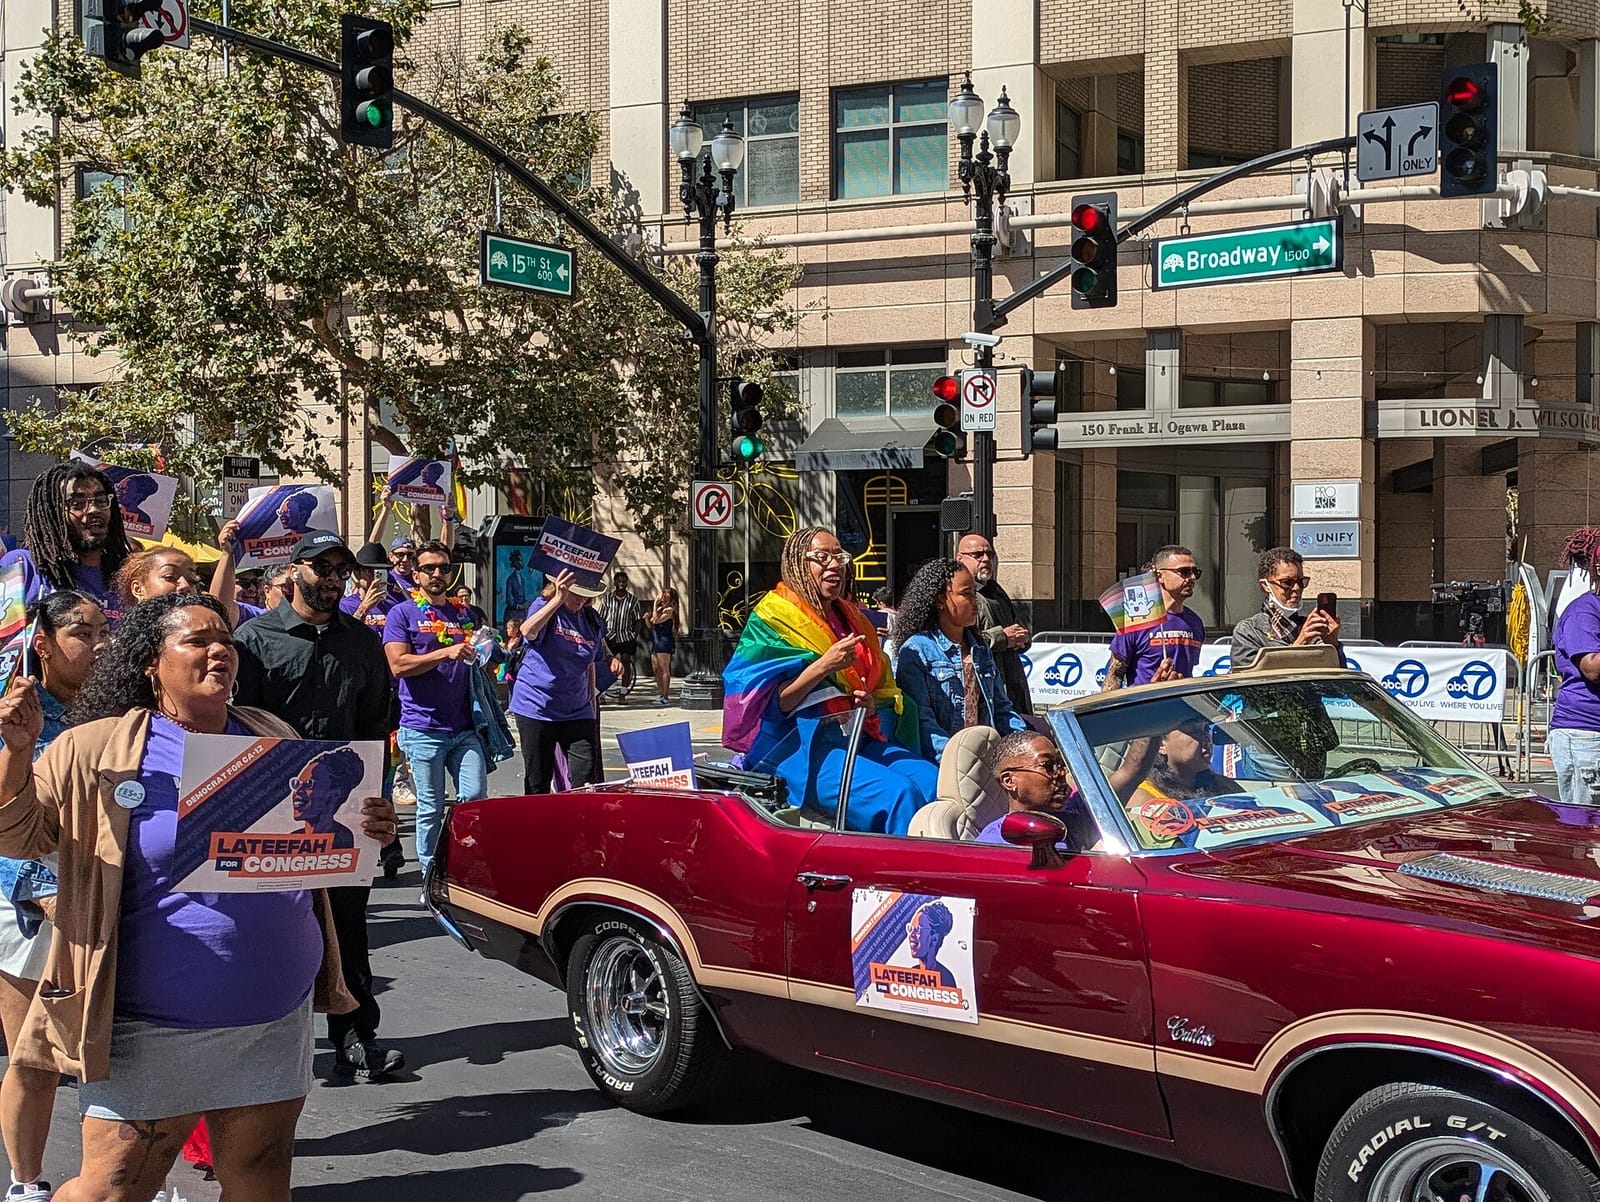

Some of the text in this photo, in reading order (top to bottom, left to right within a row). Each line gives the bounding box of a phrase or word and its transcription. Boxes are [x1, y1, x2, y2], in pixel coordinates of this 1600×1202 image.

[1403, 157, 1432, 171] ONLY
[511, 253, 551, 274] 15TH St
[1187, 245, 1310, 271] Broadway 1500
[537, 270, 553, 281] 600
[964, 413, 994, 423] ON RED
[1420, 409, 1499, 428] LIONEL
[1507, 409, 1522, 430] J.
[1532, 409, 1589, 429] WILSON
[1081, 419, 1246, 436] 150 Frank H. Ogawa Plaza
[231, 458, 251, 468] RIGHT
[232, 468, 251, 478] LANE
[1315, 486, 1336, 498] PRO
[1316, 532, 1354, 543] UNIFY
[544, 536, 596, 560] LATEEFAH
[554, 548, 605, 571] CONGRESS
[1419, 700, 1435, 708] LIVE
[1440, 701, 1503, 711] WHERE YOU LIVE
[631, 763, 669, 779] ATEEFAH
[185, 772, 229, 807] DEMOCRAT
[226, 761, 245, 776] FOR
[1225, 815, 1307, 832] CONGRESS
[217, 838, 327, 855] LATEEFAH
[220, 853, 353, 873] FOR CONGRESS
[595, 921, 646, 945] COOPER
[874, 968, 937, 988] LATEEFAH
[889, 983, 961, 1006] CONGRESS
[591, 1055, 635, 1092] RADIAL
[1347, 1114, 1508, 1184] RADIAL G/T
